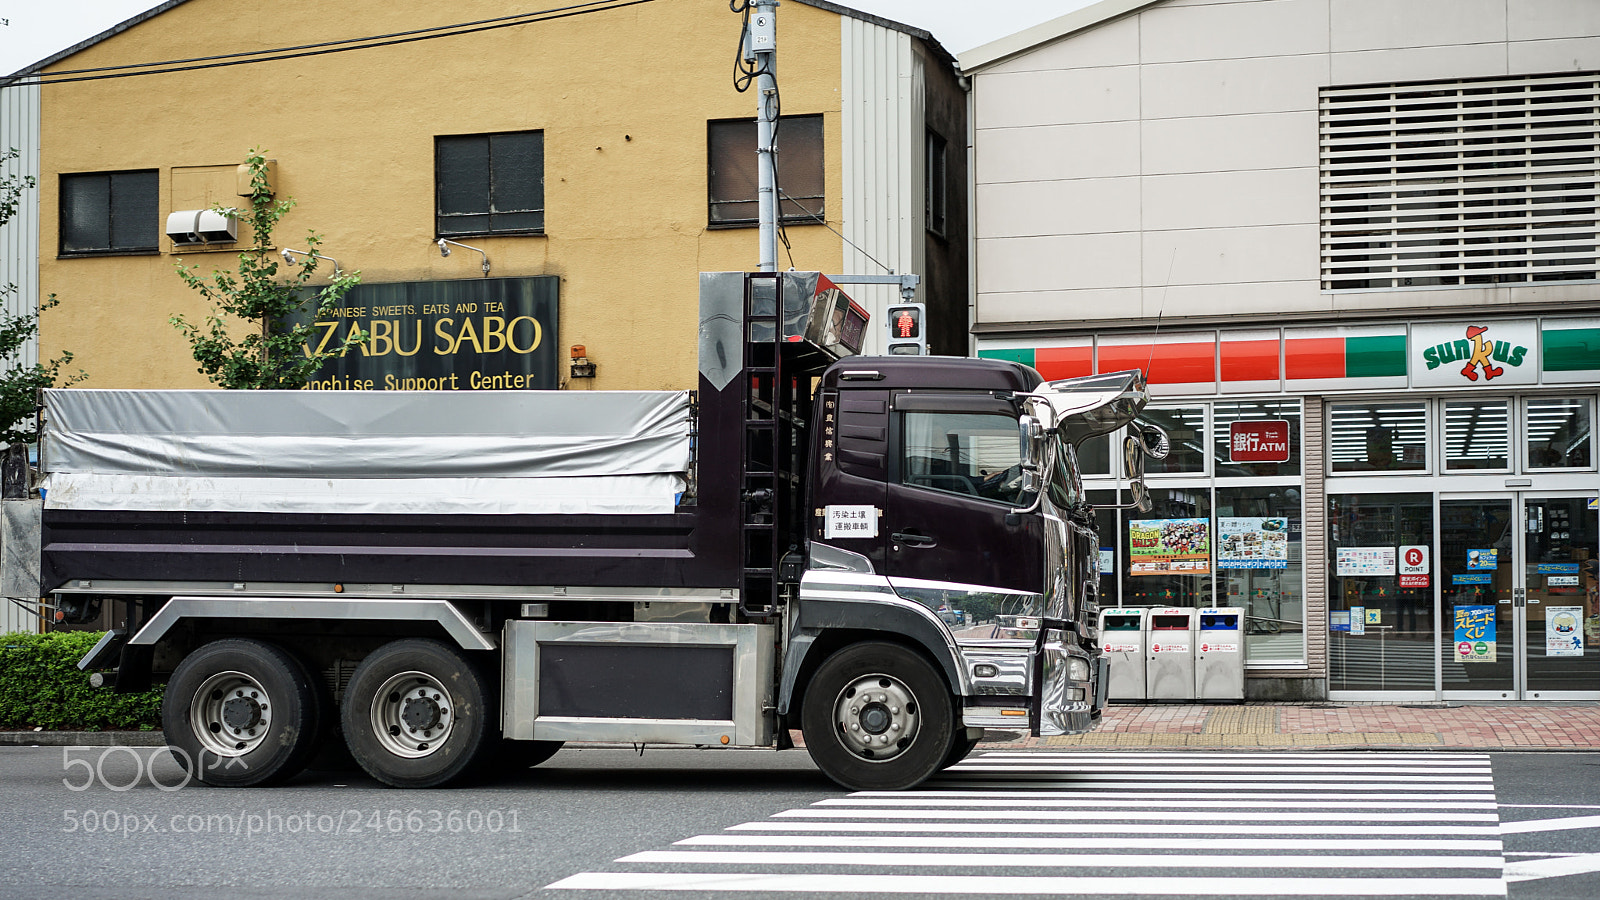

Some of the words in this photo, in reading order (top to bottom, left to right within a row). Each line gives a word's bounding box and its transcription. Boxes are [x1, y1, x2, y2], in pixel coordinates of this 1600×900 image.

[314, 306, 367, 319] JPANESE
[423, 303, 451, 315] EATS
[455, 302, 478, 314] AND
[484, 301, 505, 313] TEA
[433, 315, 543, 356] SABO
[279, 374, 374, 391] anchise
[384, 372, 460, 391] Support
[470, 370, 535, 390] Center
[1233, 432, 1260, 452] 銀行
[1259, 442, 1286, 452] ATM
[1131, 529, 1160, 540] DRAGON
[1409, 551, 1420, 563] R
[1455, 613, 1495, 630] スピード
[1465, 626, 1486, 640] くじ
